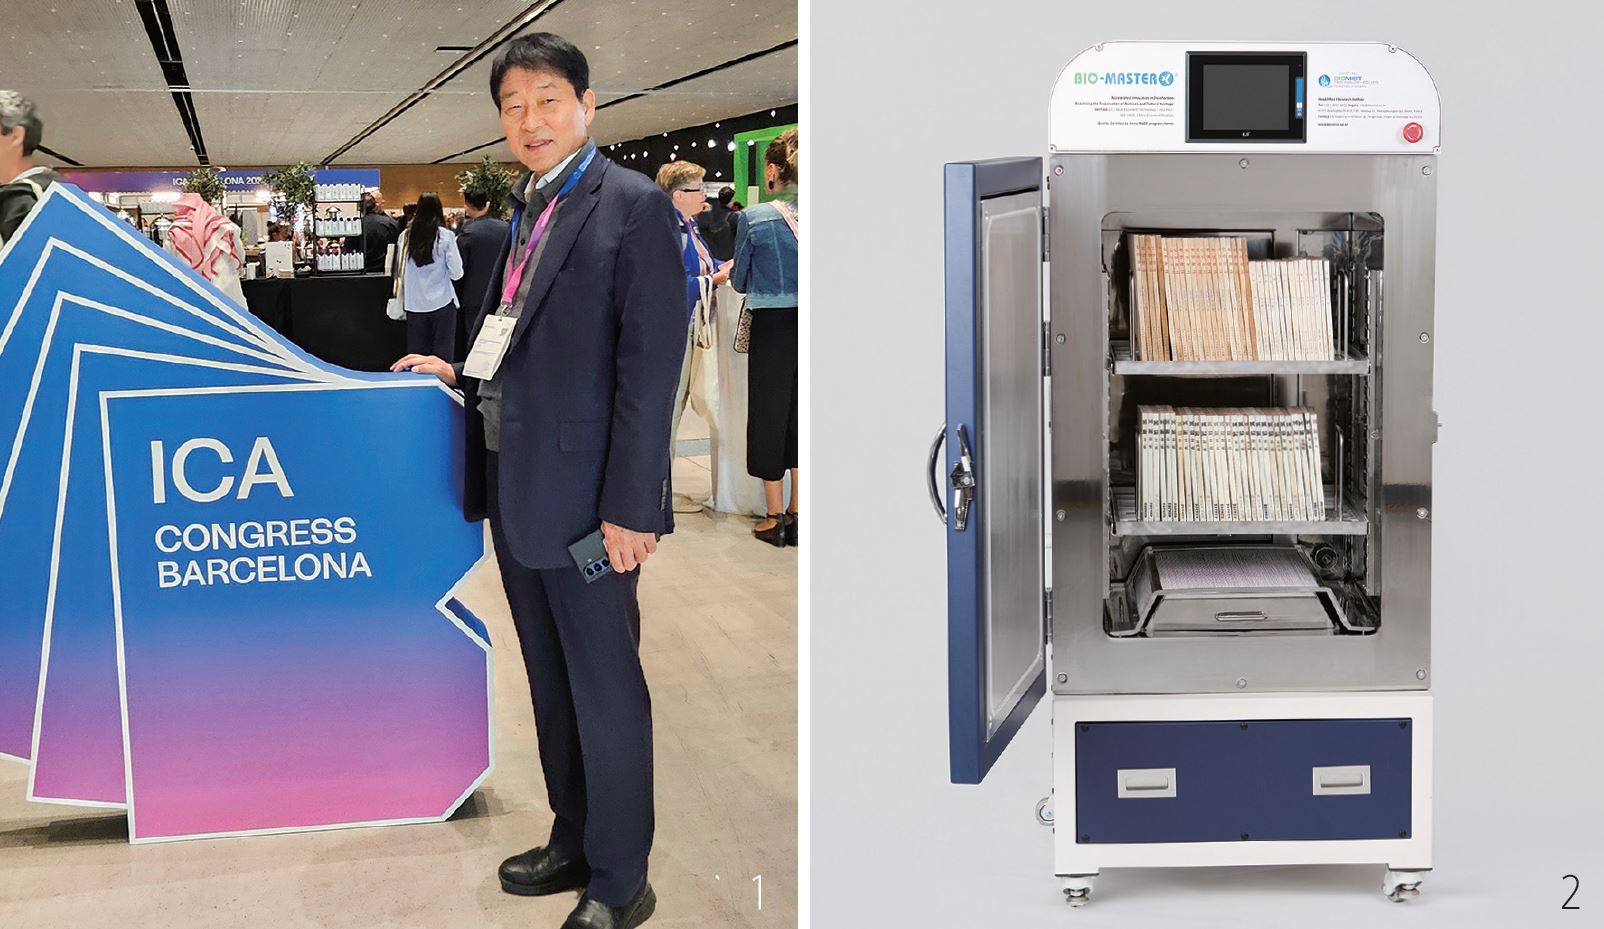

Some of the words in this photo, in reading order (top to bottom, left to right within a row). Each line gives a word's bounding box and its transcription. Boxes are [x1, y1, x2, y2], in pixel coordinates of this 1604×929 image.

[150, 436, 294, 504] ICA
[155, 516, 357, 553] CONGRESS
[158, 551, 372, 588] BARCELONA
